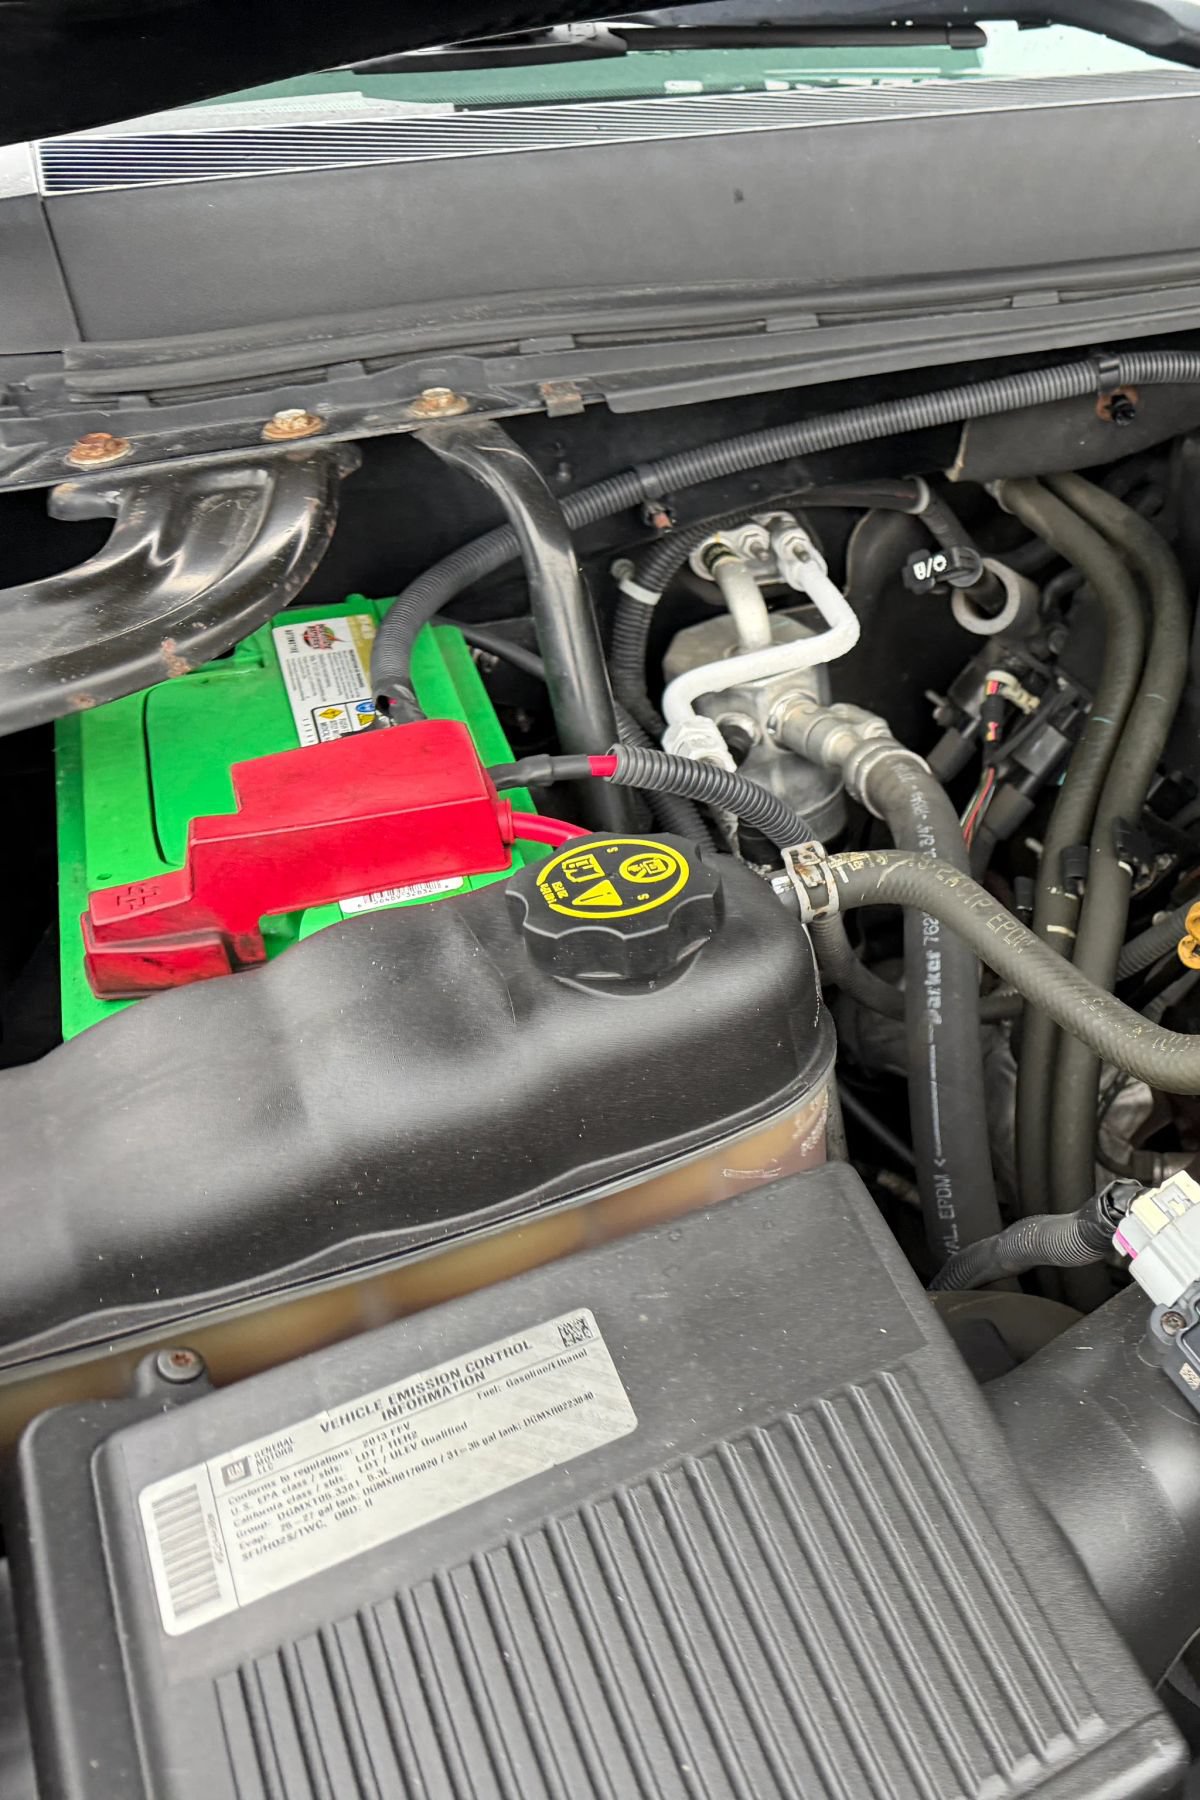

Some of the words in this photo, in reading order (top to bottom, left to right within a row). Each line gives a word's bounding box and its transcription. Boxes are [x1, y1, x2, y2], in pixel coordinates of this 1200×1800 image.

[922, 949, 943, 1025] Parker
[318, 1398, 382, 1435] VEHICLE
[386, 1366, 462, 1406] EMISSION
[463, 1337, 533, 1375] CONTROL
[380, 1369, 486, 1422] INFORMATION
